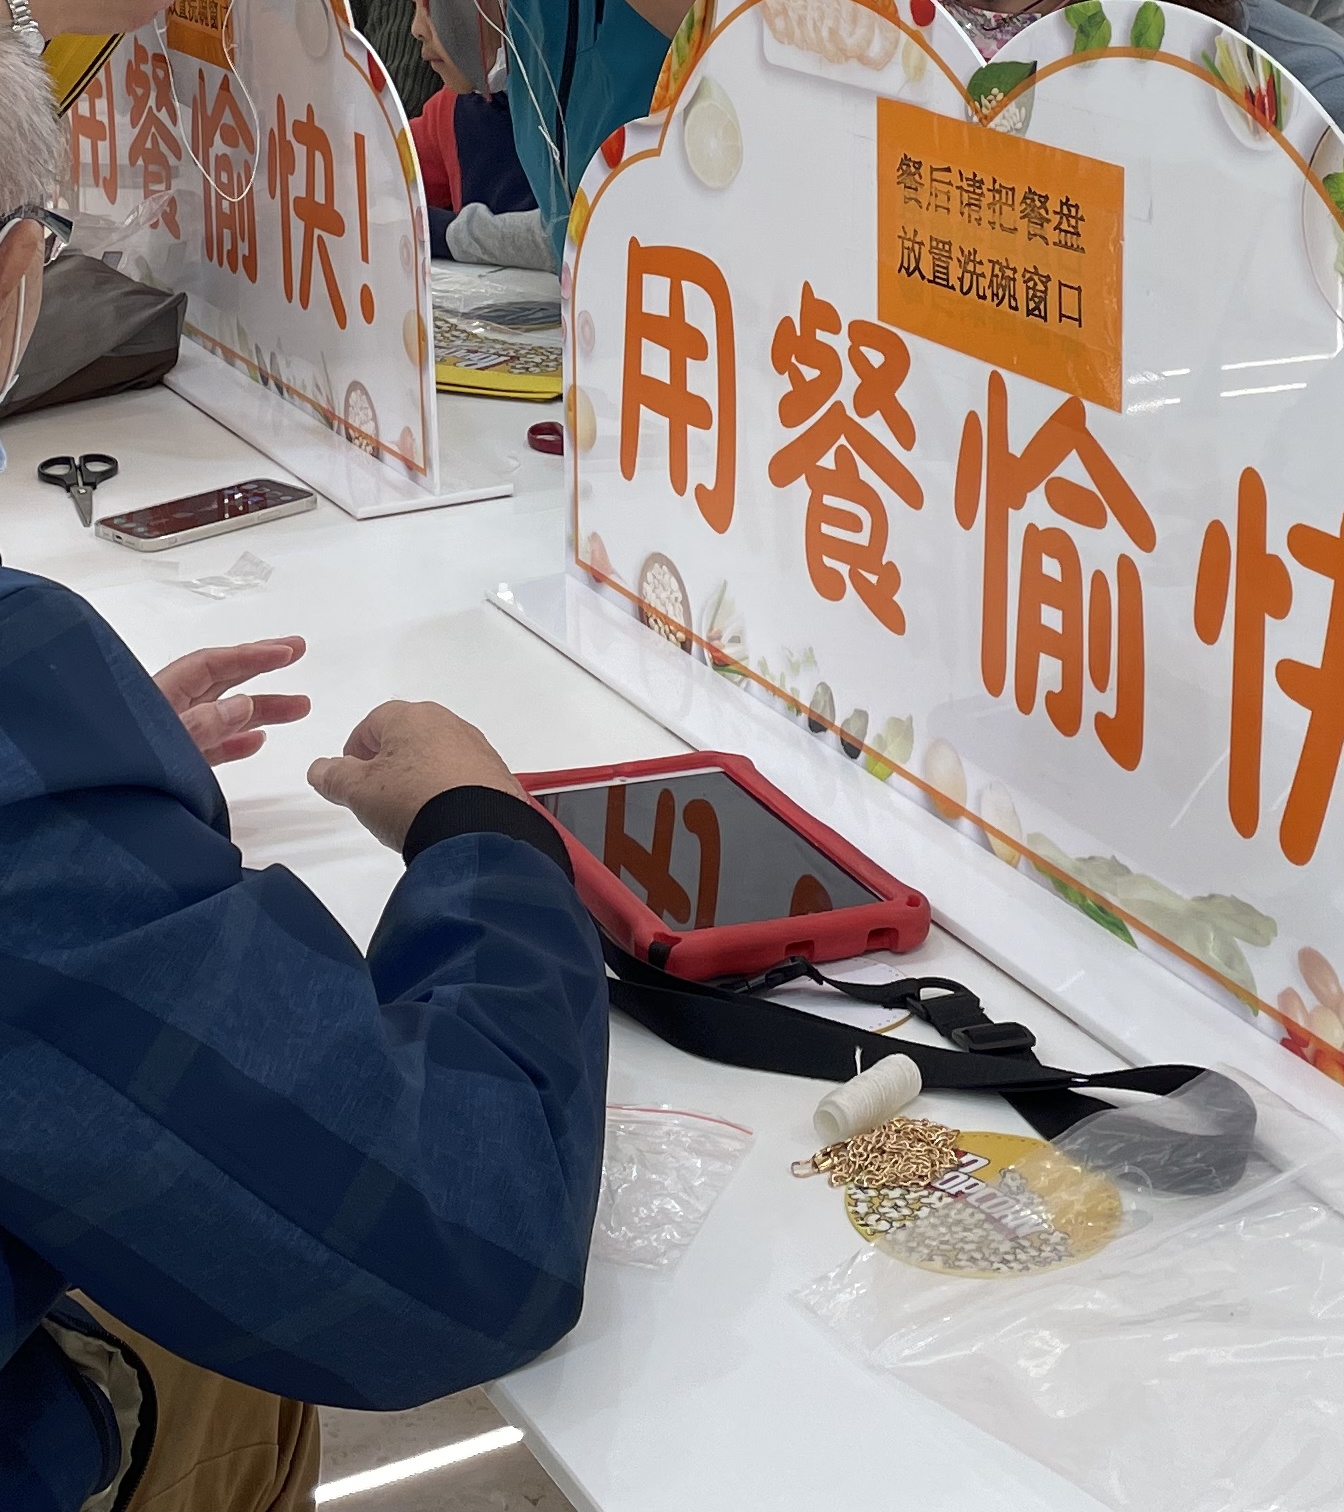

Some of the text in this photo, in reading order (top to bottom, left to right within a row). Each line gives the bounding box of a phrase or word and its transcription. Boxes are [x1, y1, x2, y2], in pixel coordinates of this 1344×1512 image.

[896, 152, 1086, 255] 餐后请把餐盘
[896, 225, 1084, 329] 放置洗碗窗口
